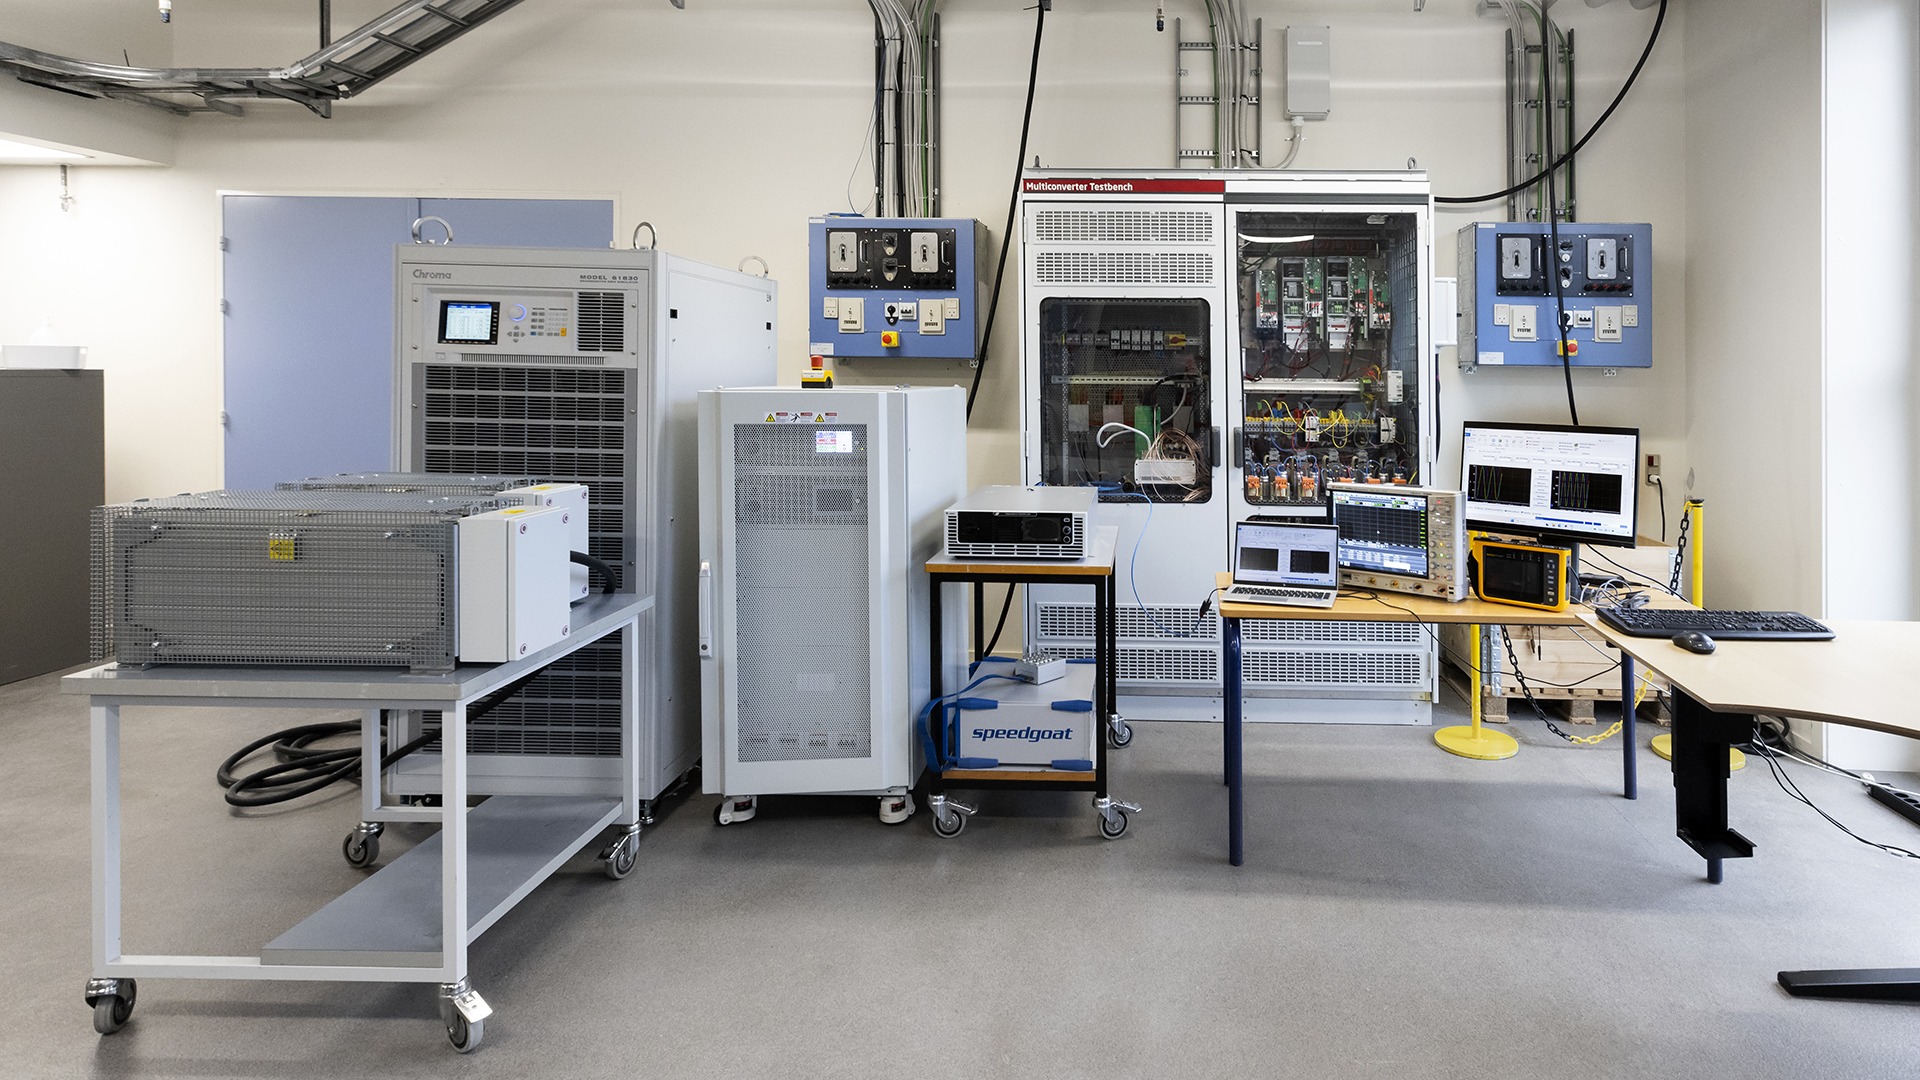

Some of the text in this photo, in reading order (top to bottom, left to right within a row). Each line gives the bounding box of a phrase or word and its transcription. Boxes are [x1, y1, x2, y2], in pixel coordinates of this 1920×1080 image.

[1026, 182, 1133, 191] Multiconverter Testbench
[412, 269, 452, 279] Chroma
[972, 726, 1073, 743] speedgoat
